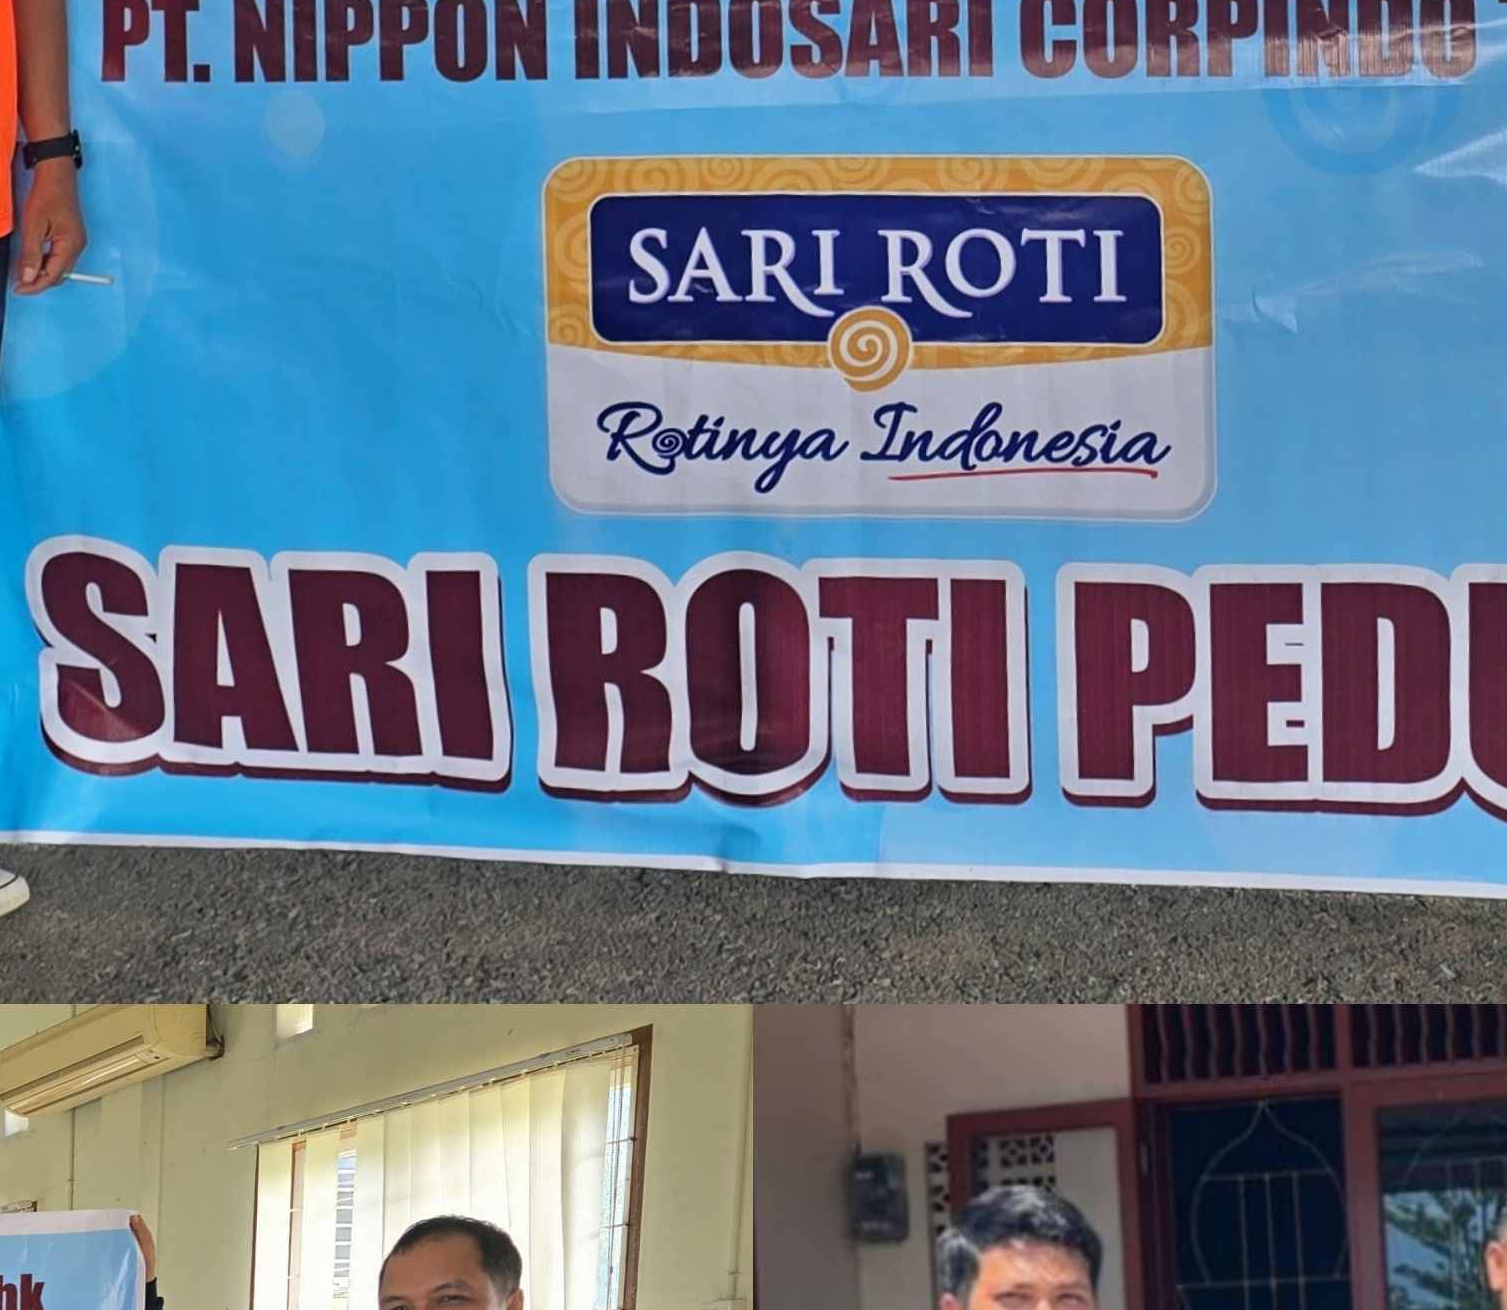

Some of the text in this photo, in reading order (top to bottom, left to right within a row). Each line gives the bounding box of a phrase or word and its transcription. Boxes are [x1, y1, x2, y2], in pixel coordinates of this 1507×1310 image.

[628, 228, 1127, 318] SARI ROTI
[597, 401, 1171, 493] Rotinya Indonesia
[31, 539, 504, 789] SARI
[538, 555, 1018, 804] ROTI
